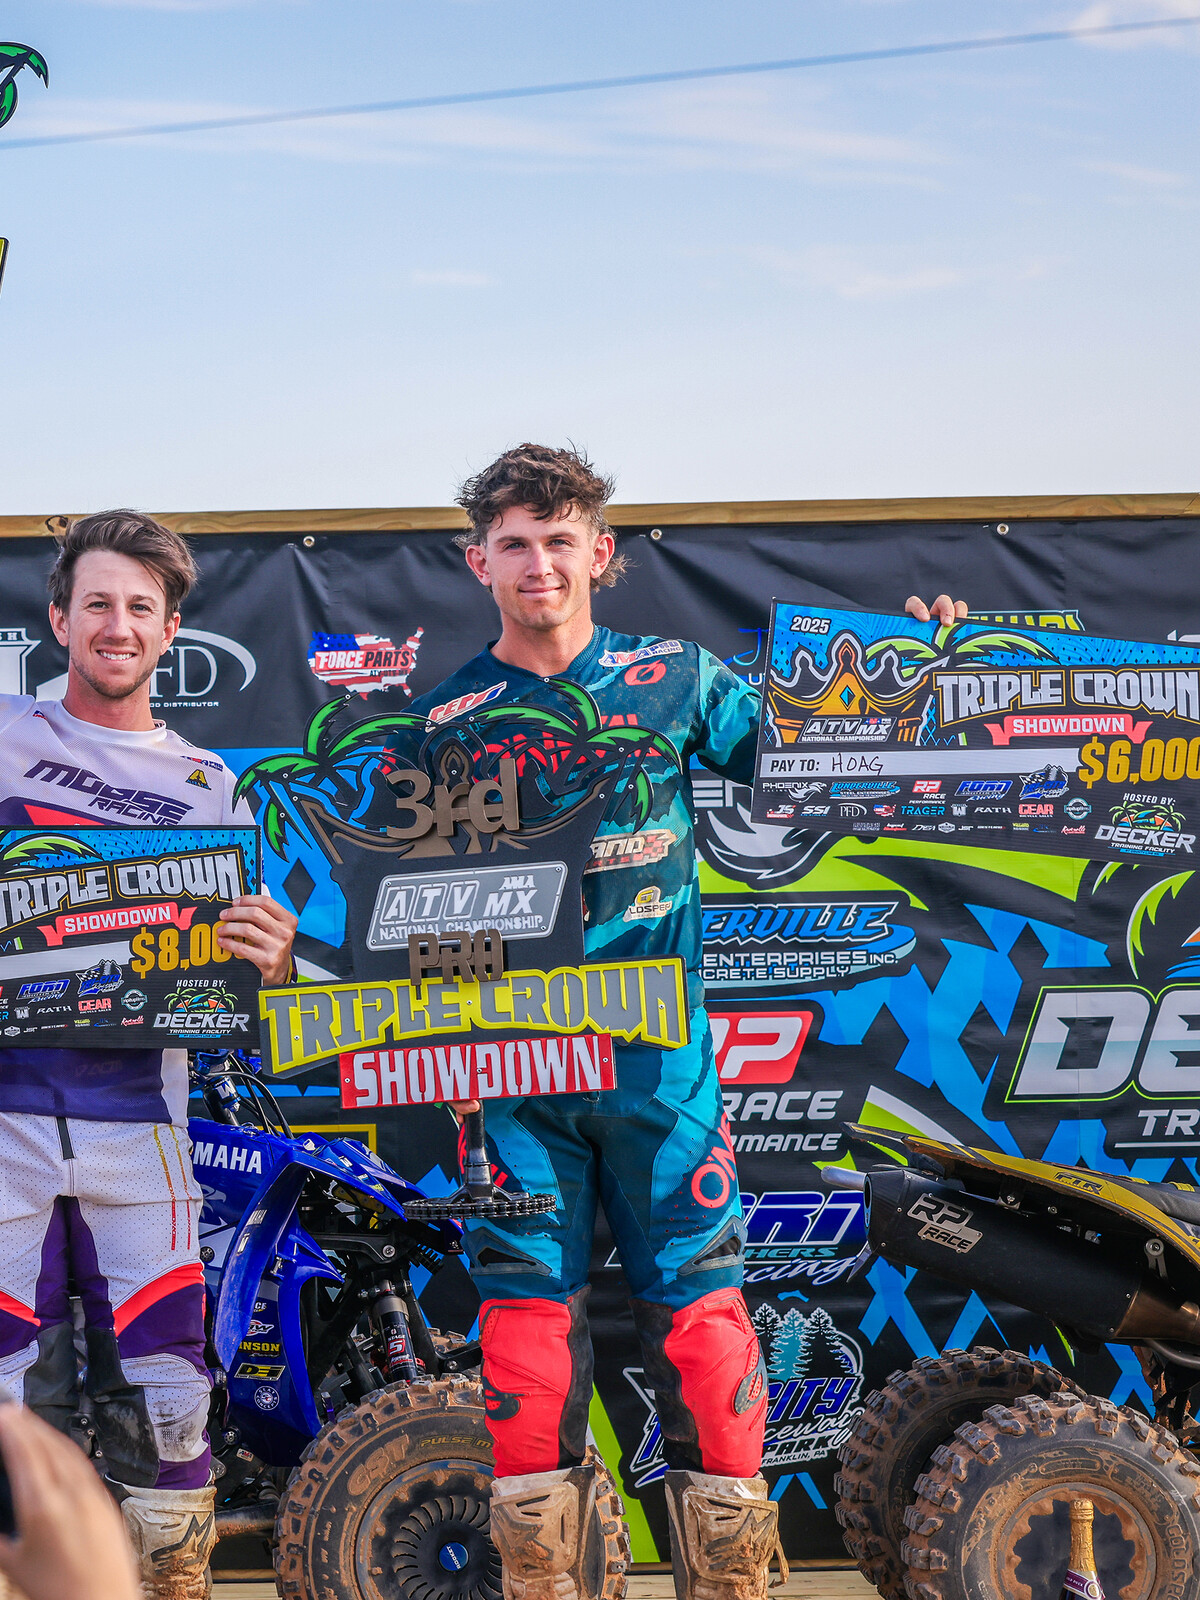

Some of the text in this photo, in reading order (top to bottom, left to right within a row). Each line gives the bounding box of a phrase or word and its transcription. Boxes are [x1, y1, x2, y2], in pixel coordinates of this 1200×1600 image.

[790, 616, 831, 634] 2025
[316, 651, 410, 668] FORCE PARTS
[604, 640, 680, 666] AMA PRO
[936, 671, 1200, 723] TRIPLE CROWN
[807, 719, 892, 737] ATV MX
[1013, 717, 1125, 734] SHOWDOWN
[801, 734, 887, 743] NATIONAL CHAMPIONSHIP
[770, 759, 820, 772] PAY TO:
[831, 752, 884, 776] HOAG
[1078, 736, 1200, 790] $6,000
[23, 758, 195, 822] MOOSE
[762, 782, 809, 790] PHOENIX
[913, 780, 942, 793] RP
[386, 758, 520, 839] 3rd
[1123, 792, 1176, 806] HOSTED BY:
[88, 796, 180, 826] RACING
[801, 806, 831, 815] SSI
[840, 806, 860, 817] PFD
[901, 805, 946, 816] TRAGER
[974, 806, 1012, 814] RATH
[1019, 803, 1054, 815] GEAR
[1094, 824, 1196, 853] DECKER
[1111, 842, 1144, 850] TRAINING
[1144, 845, 1175, 854] FACILITY
[117, 853, 242, 901] CROWN
[383, 883, 538, 920] ATV MX
[64, 906, 172, 934] SHOWDOWN
[379, 914, 544, 941] NATIONAL CHAMPIONSHIP
[409, 929, 504, 986] PRO
[704, 951, 899, 967] ENTERPRISES INC.
[773, 966, 850, 980] SUPPLY
[176, 979, 227, 988] HOSTED BY:
[36, 1005, 73, 1015] RATH
[77, 997, 112, 1012] GEAR
[153, 1012, 250, 1032] DECKER
[265, 965, 682, 1067] TRIPLE CROWN
[354, 1035, 601, 1108] SHOWDOWN
[722, 1090, 844, 1121] RACE
[193, 1141, 262, 1175] MAHA
[911, 1196, 970, 1227] RP
[923, 1226, 973, 1250] RACE
[389, 1339, 404, 1356] 5
[420, 1435, 472, 1448] PULSE
[813, 1450, 827, 1459] PA
[446, 1545, 462, 1570] ROCKET
